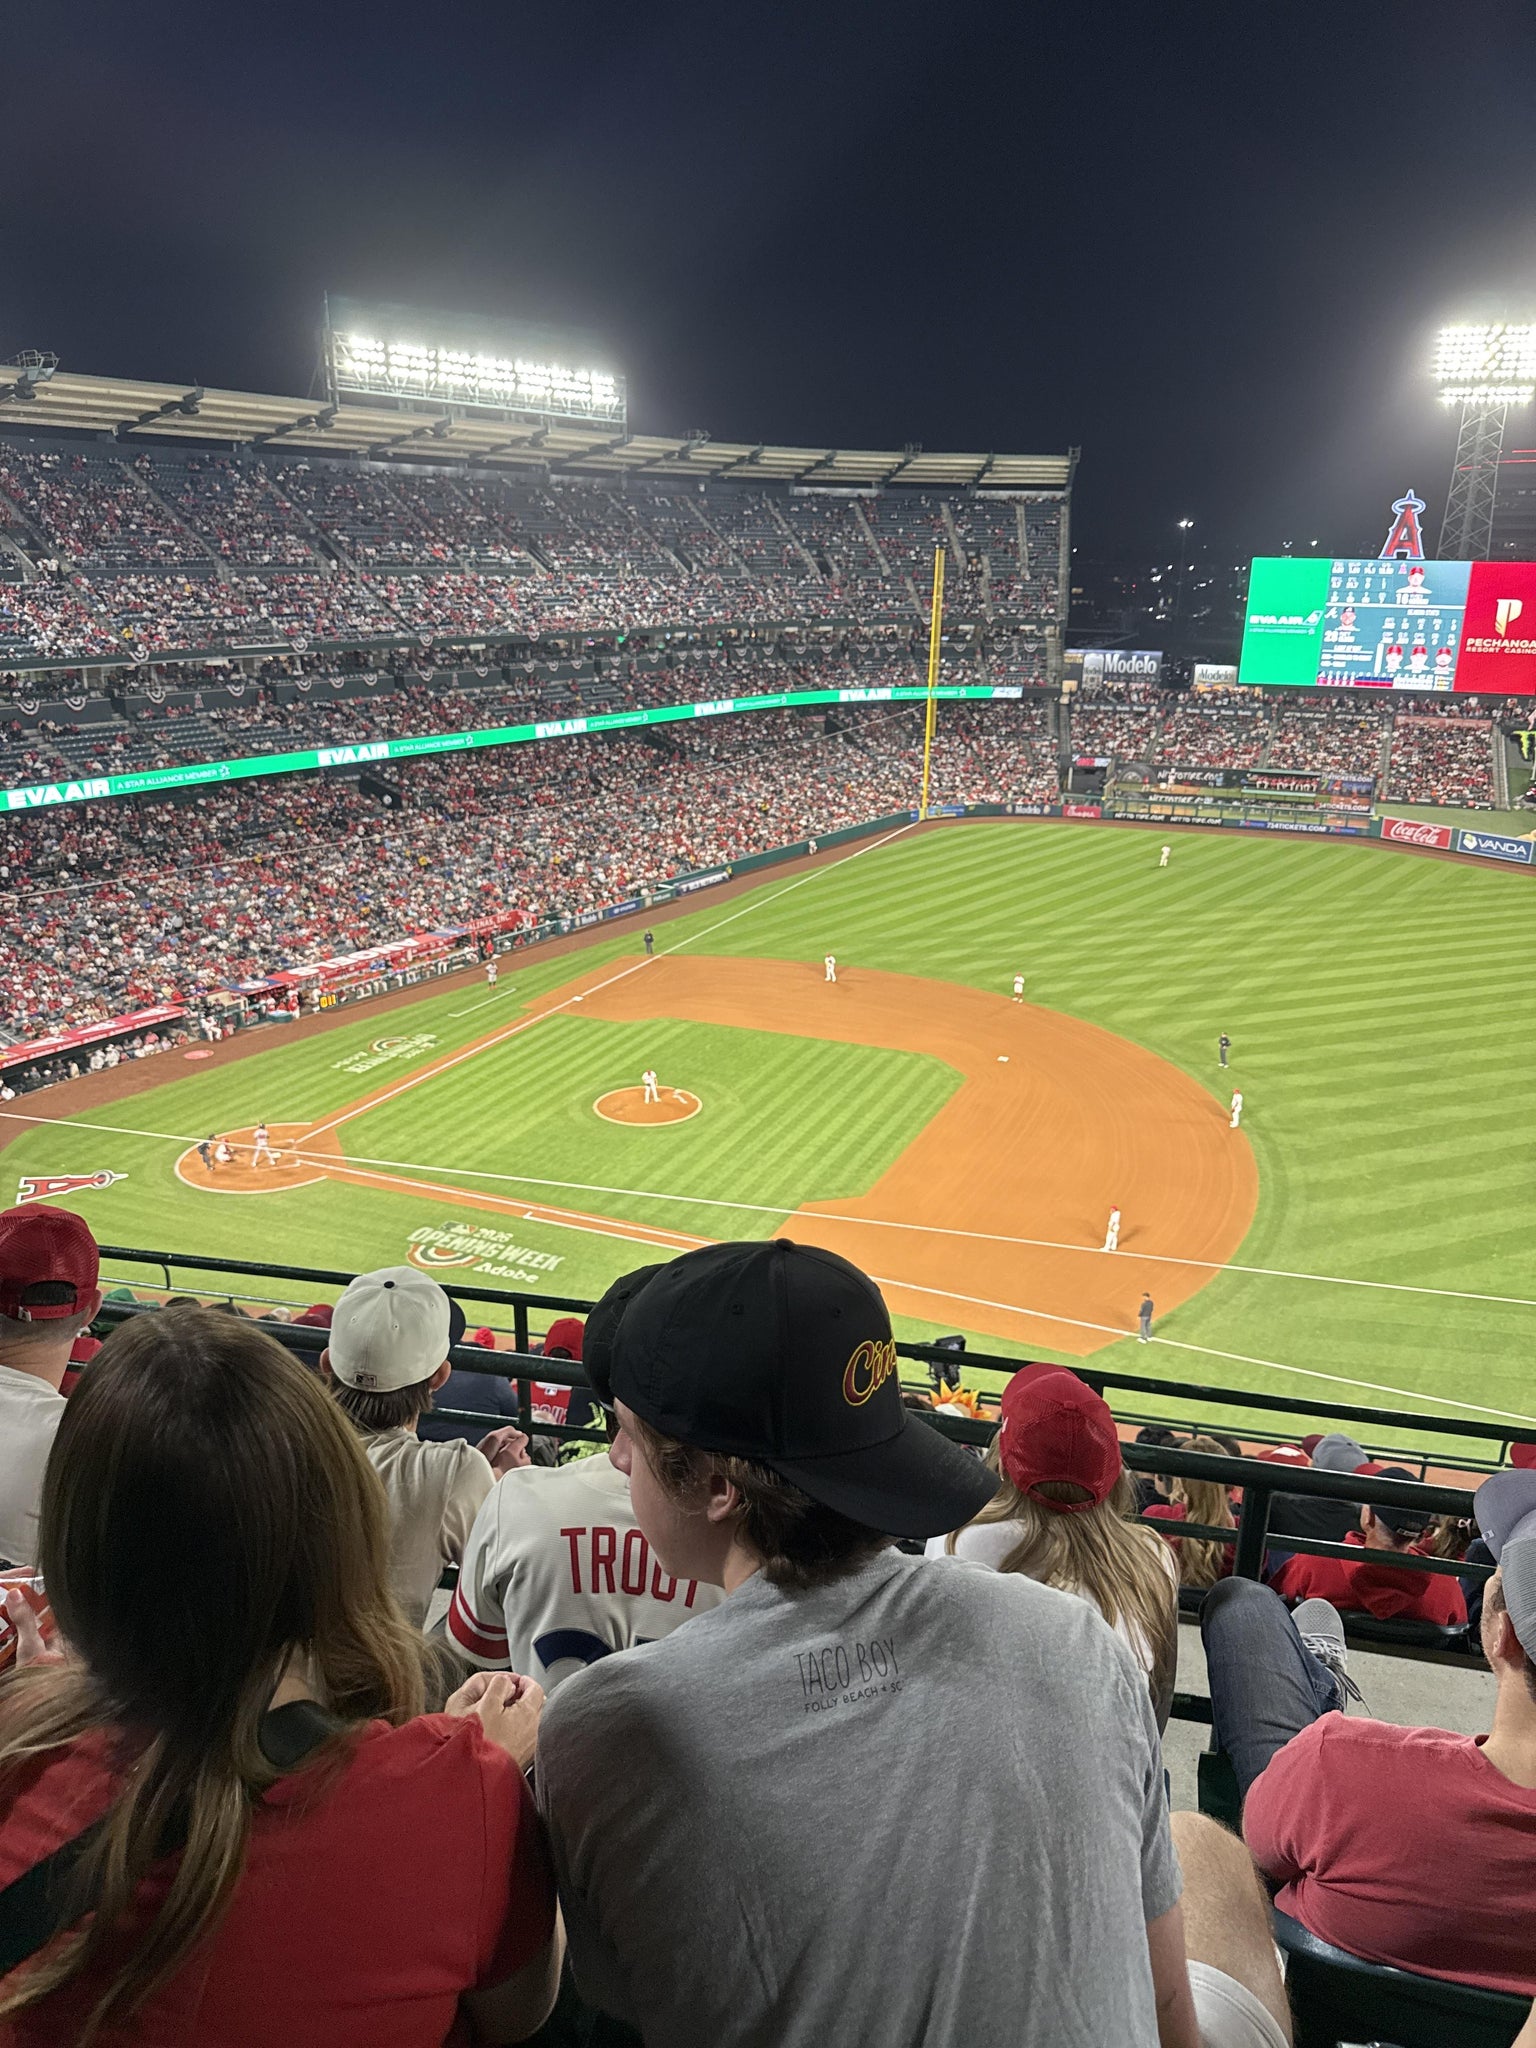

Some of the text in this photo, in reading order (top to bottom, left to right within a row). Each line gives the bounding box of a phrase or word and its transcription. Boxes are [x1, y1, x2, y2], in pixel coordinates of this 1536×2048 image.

[1465, 646, 1501, 654] RESORT
[1466, 638, 1536, 649] PECHANGA
[1104, 653, 1157, 674] Modelo
[1200, 668, 1233, 682] Modelo
[125, 777, 145, 789] STAR
[146, 772, 183, 786] ALLIANCE
[184, 769, 218, 781] MEMBER
[1478, 838, 1527, 855] VANDA
[407, 1226, 566, 1271] OPENING WEEK
[472, 1262, 540, 1284] Adobe
[793, 1637, 899, 1696] TACO BOY
[804, 1681, 903, 1713] FOLLY BEACH SC
